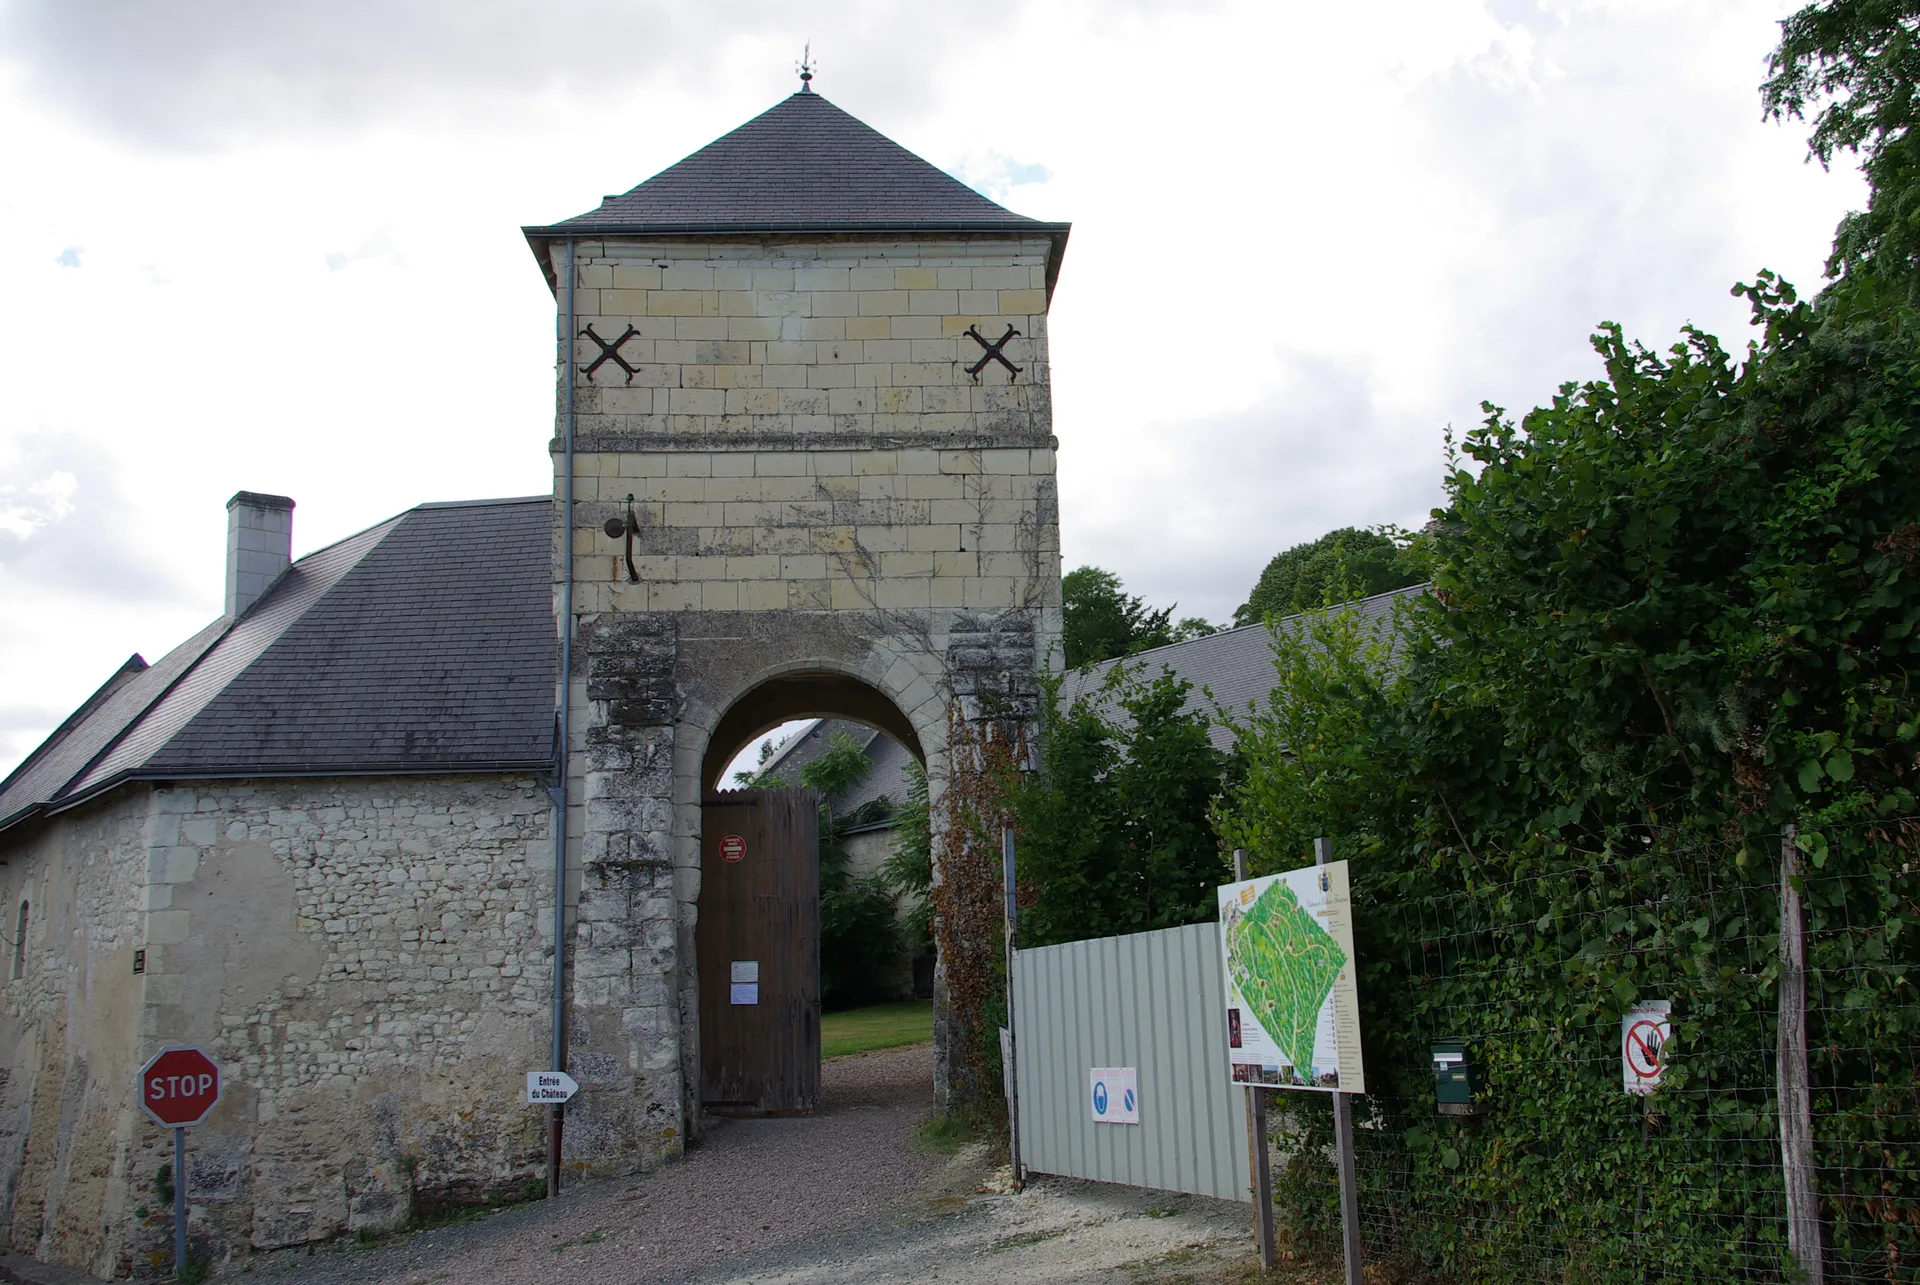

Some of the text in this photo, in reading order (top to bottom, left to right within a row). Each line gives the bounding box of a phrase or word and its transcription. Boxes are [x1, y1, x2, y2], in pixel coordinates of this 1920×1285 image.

[539, 1076, 560, 1086] Entrée
[150, 1073, 213, 1100] STOP
[532, 1089, 568, 1098] du Château
